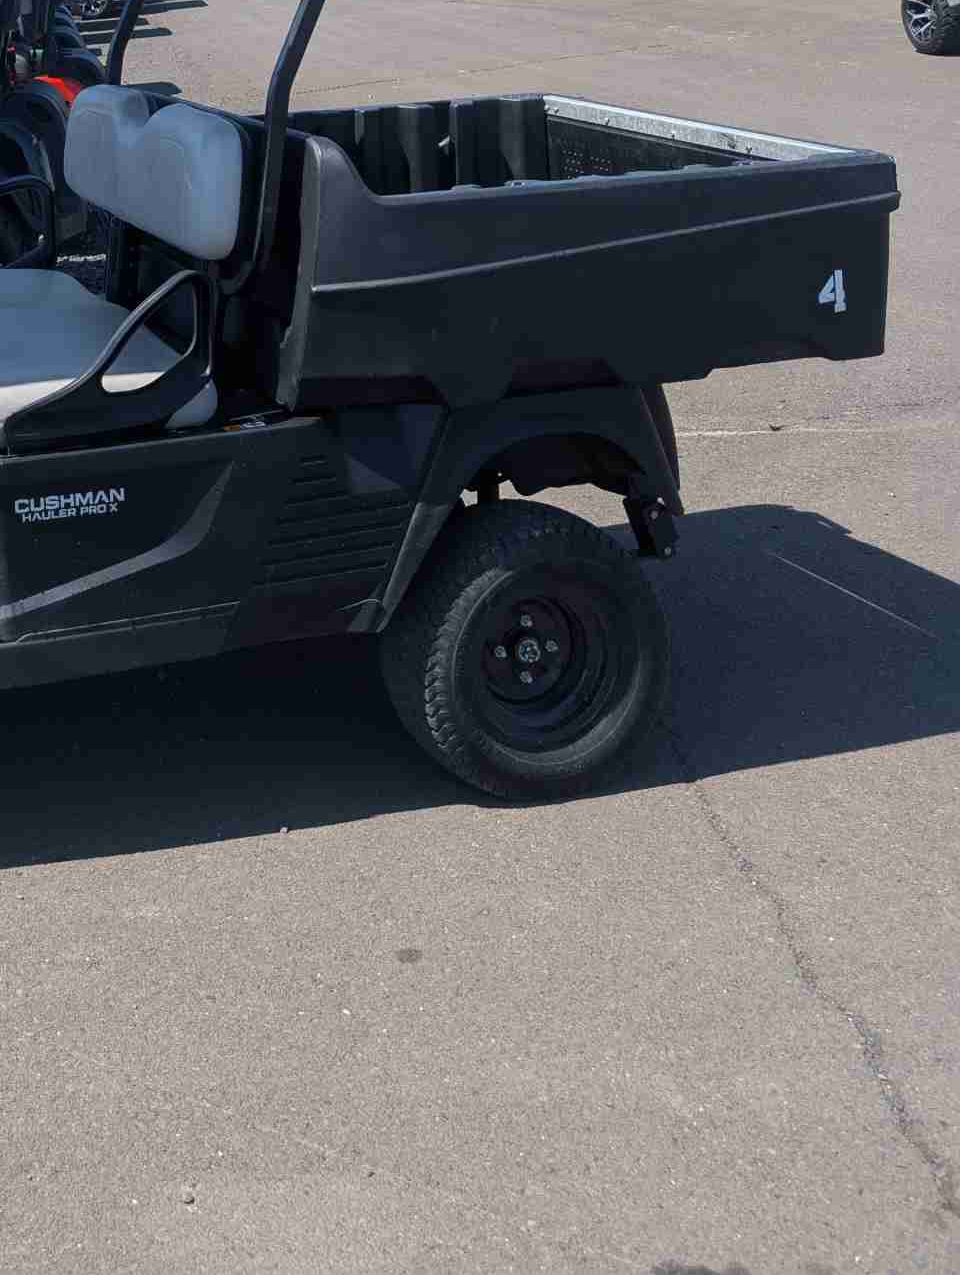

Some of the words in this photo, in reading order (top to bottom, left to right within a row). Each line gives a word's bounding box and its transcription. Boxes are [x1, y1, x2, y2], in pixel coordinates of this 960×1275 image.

[818, 269, 846, 313] 4
[14, 487, 126, 514] CUSHMAN
[21, 507, 77, 523] HAULER
[79, 504, 107, 517] PRO
[108, 502, 119, 513] X
